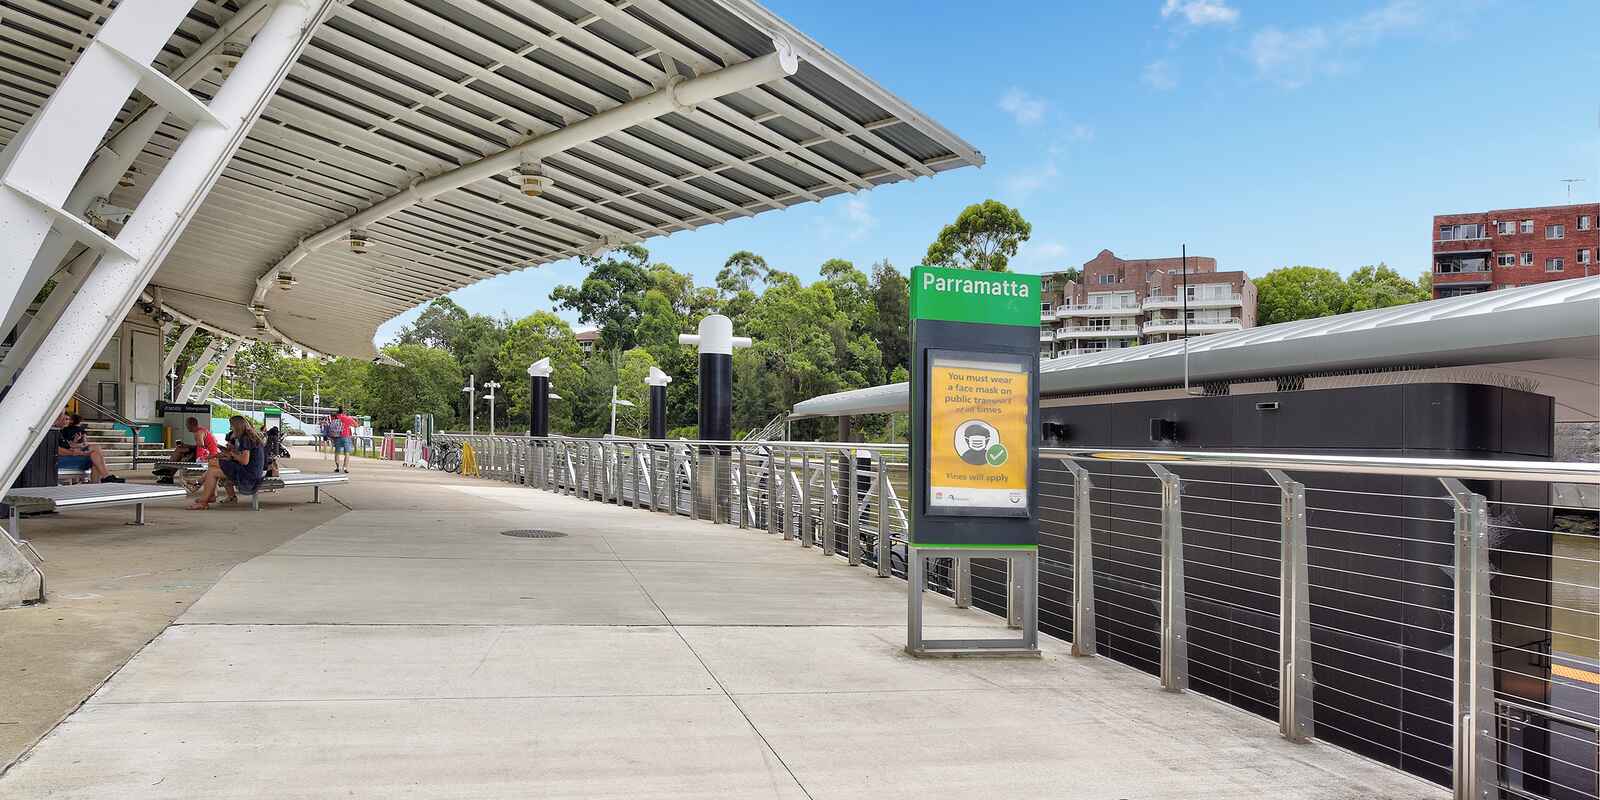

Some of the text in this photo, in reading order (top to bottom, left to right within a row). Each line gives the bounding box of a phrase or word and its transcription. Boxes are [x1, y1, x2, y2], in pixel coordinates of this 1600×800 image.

[922, 272, 1029, 298] Parramatta
[948, 372, 1013, 384] You must wear
[956, 384, 974, 392] face
[976, 386, 998, 394] mask
[945, 394, 971, 404] public
[969, 473, 984, 481] will
[986, 473, 1008, 483] apply
